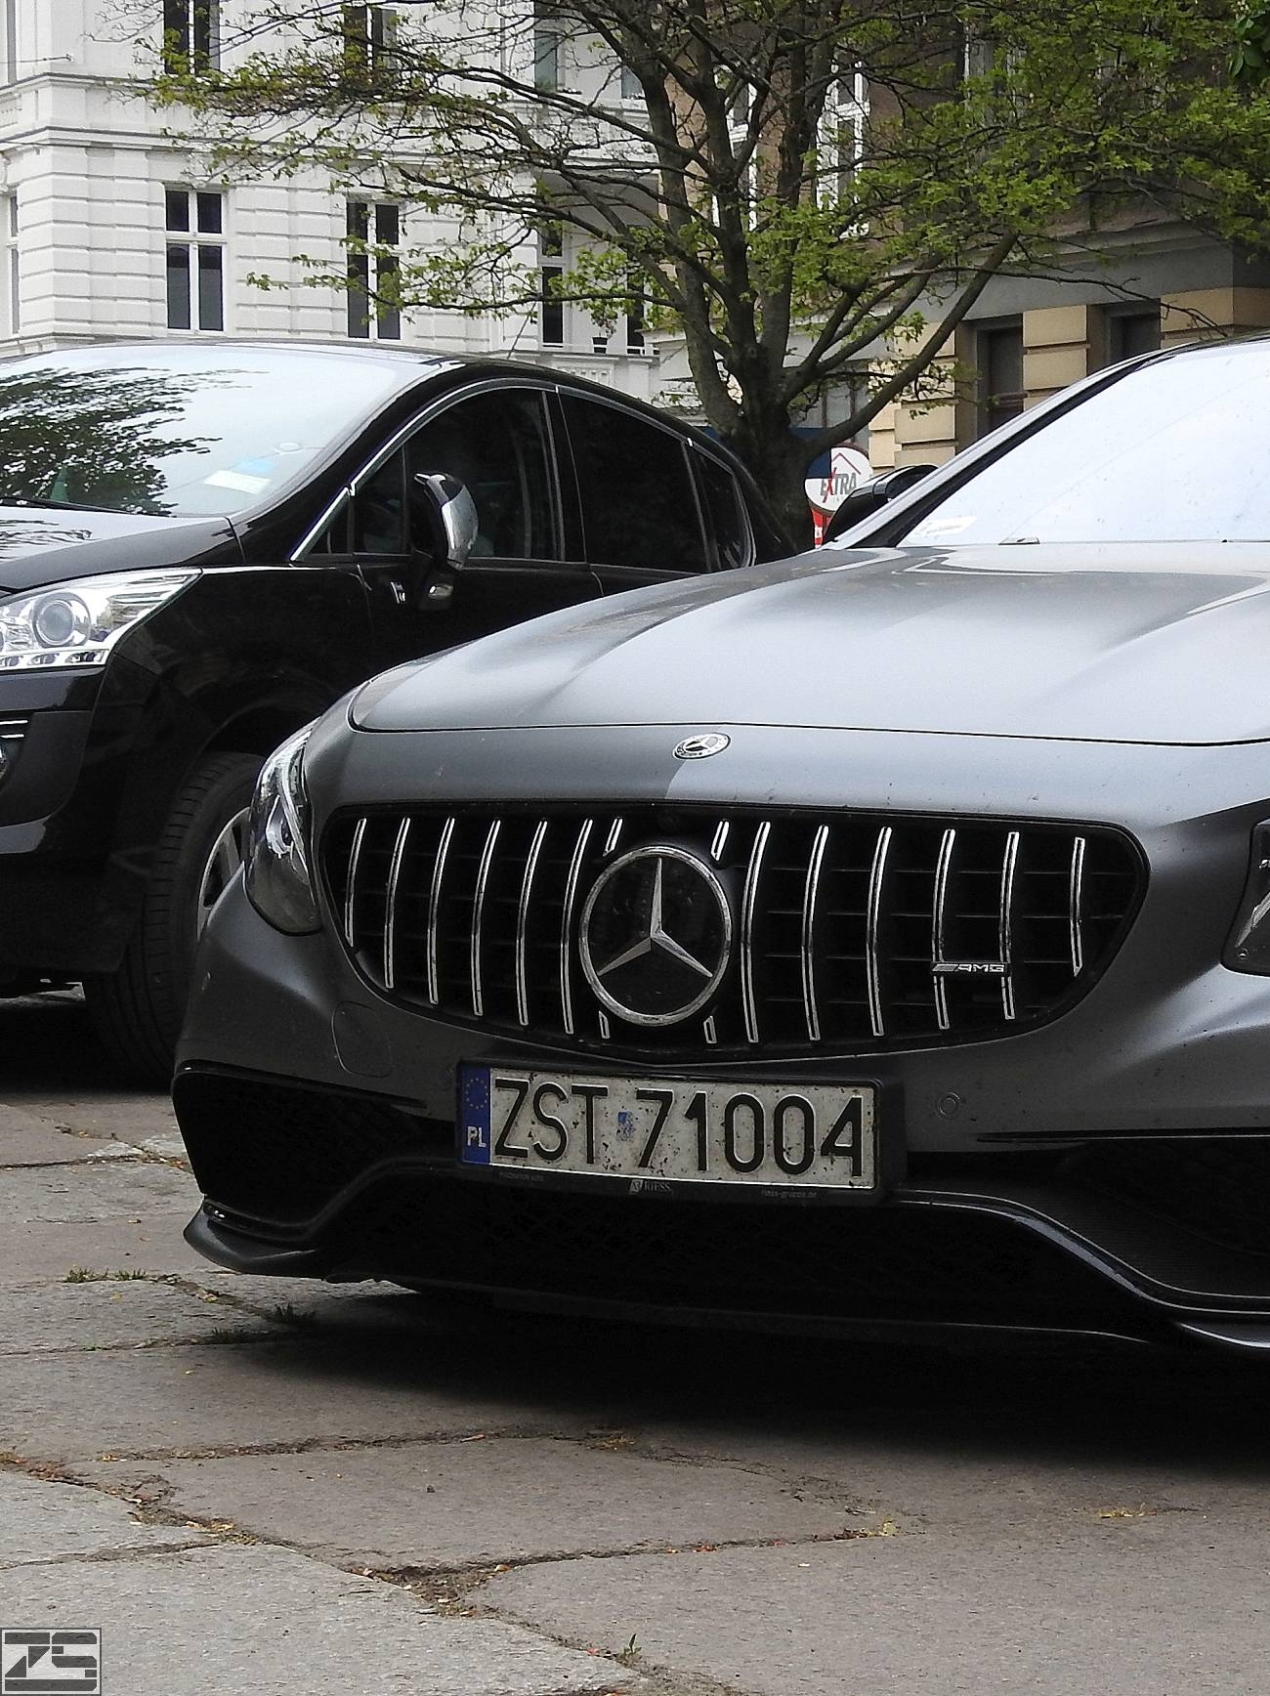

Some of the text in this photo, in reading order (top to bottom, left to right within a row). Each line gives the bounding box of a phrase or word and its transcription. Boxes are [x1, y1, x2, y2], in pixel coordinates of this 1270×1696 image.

[820, 467, 857, 503] EXTRA
[957, 963, 1005, 973] AMG
[466, 1125, 487, 1148] PL
[494, 1078, 864, 1177] ZST 71004
[644, 1180, 672, 1194] RIESS
